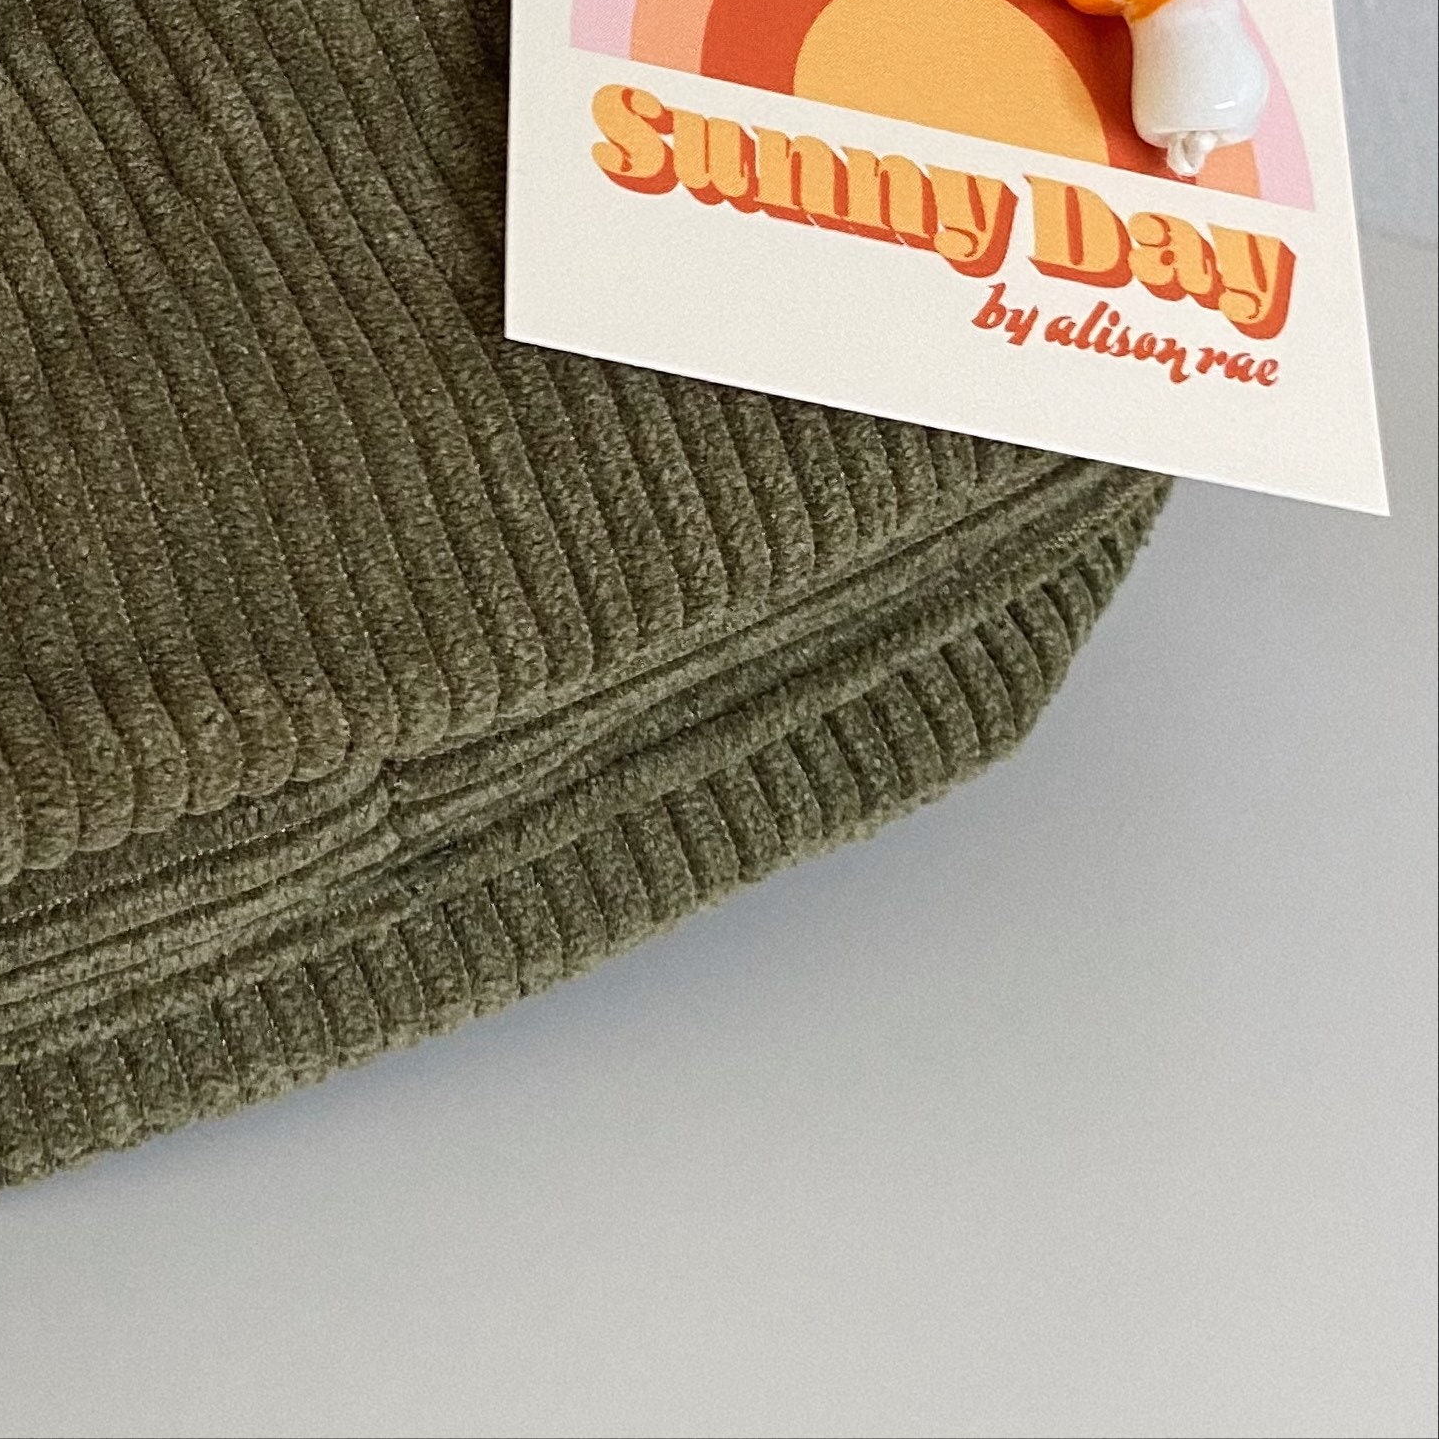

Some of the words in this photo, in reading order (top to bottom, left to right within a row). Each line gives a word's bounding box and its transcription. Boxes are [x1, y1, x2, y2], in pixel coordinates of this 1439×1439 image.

[591, 84, 1018, 278] Sunny
[1024, 174, 1297, 340] Day
[971, 282, 1039, 346] by
[1044, 301, 1190, 384] alison
[1196, 347, 1280, 387] rae
